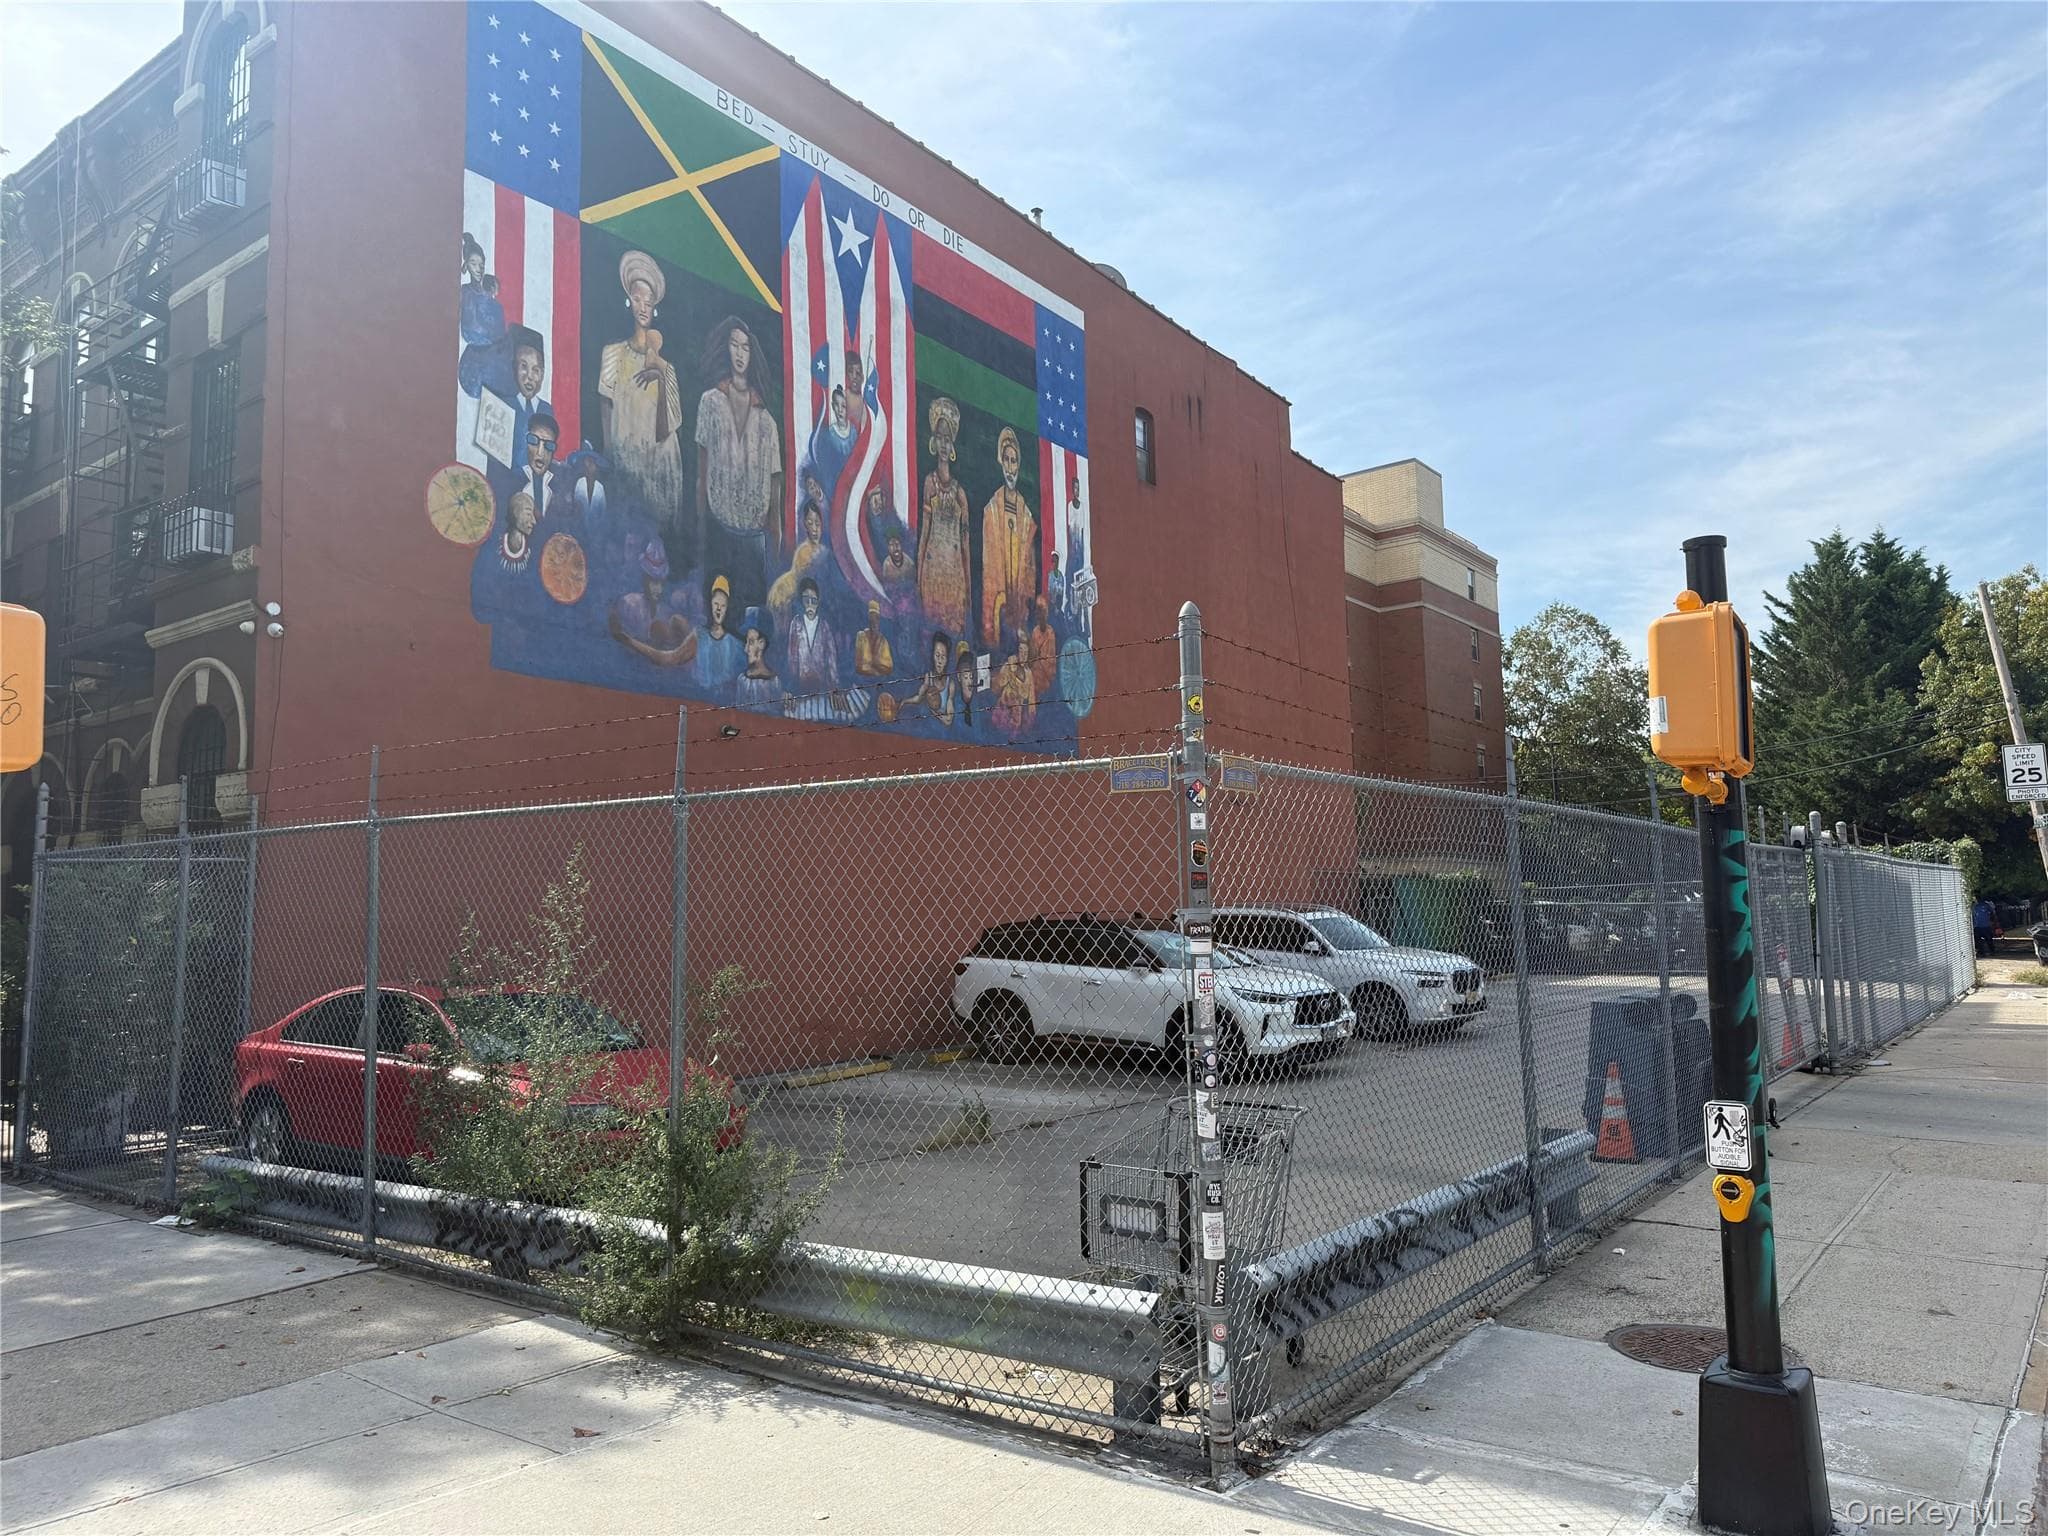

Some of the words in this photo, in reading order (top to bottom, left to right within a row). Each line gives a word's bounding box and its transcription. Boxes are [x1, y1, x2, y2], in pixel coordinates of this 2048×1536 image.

[716, 88, 754, 125] BED
[787, 134, 830, 173] STUY
[872, 184, 890, 208] DO
[908, 207, 926, 232] OR
[943, 228, 964, 254] DIE
[2011, 767, 2042, 783] 25
[1718, 1153, 1742, 1161] AUDIBLE
